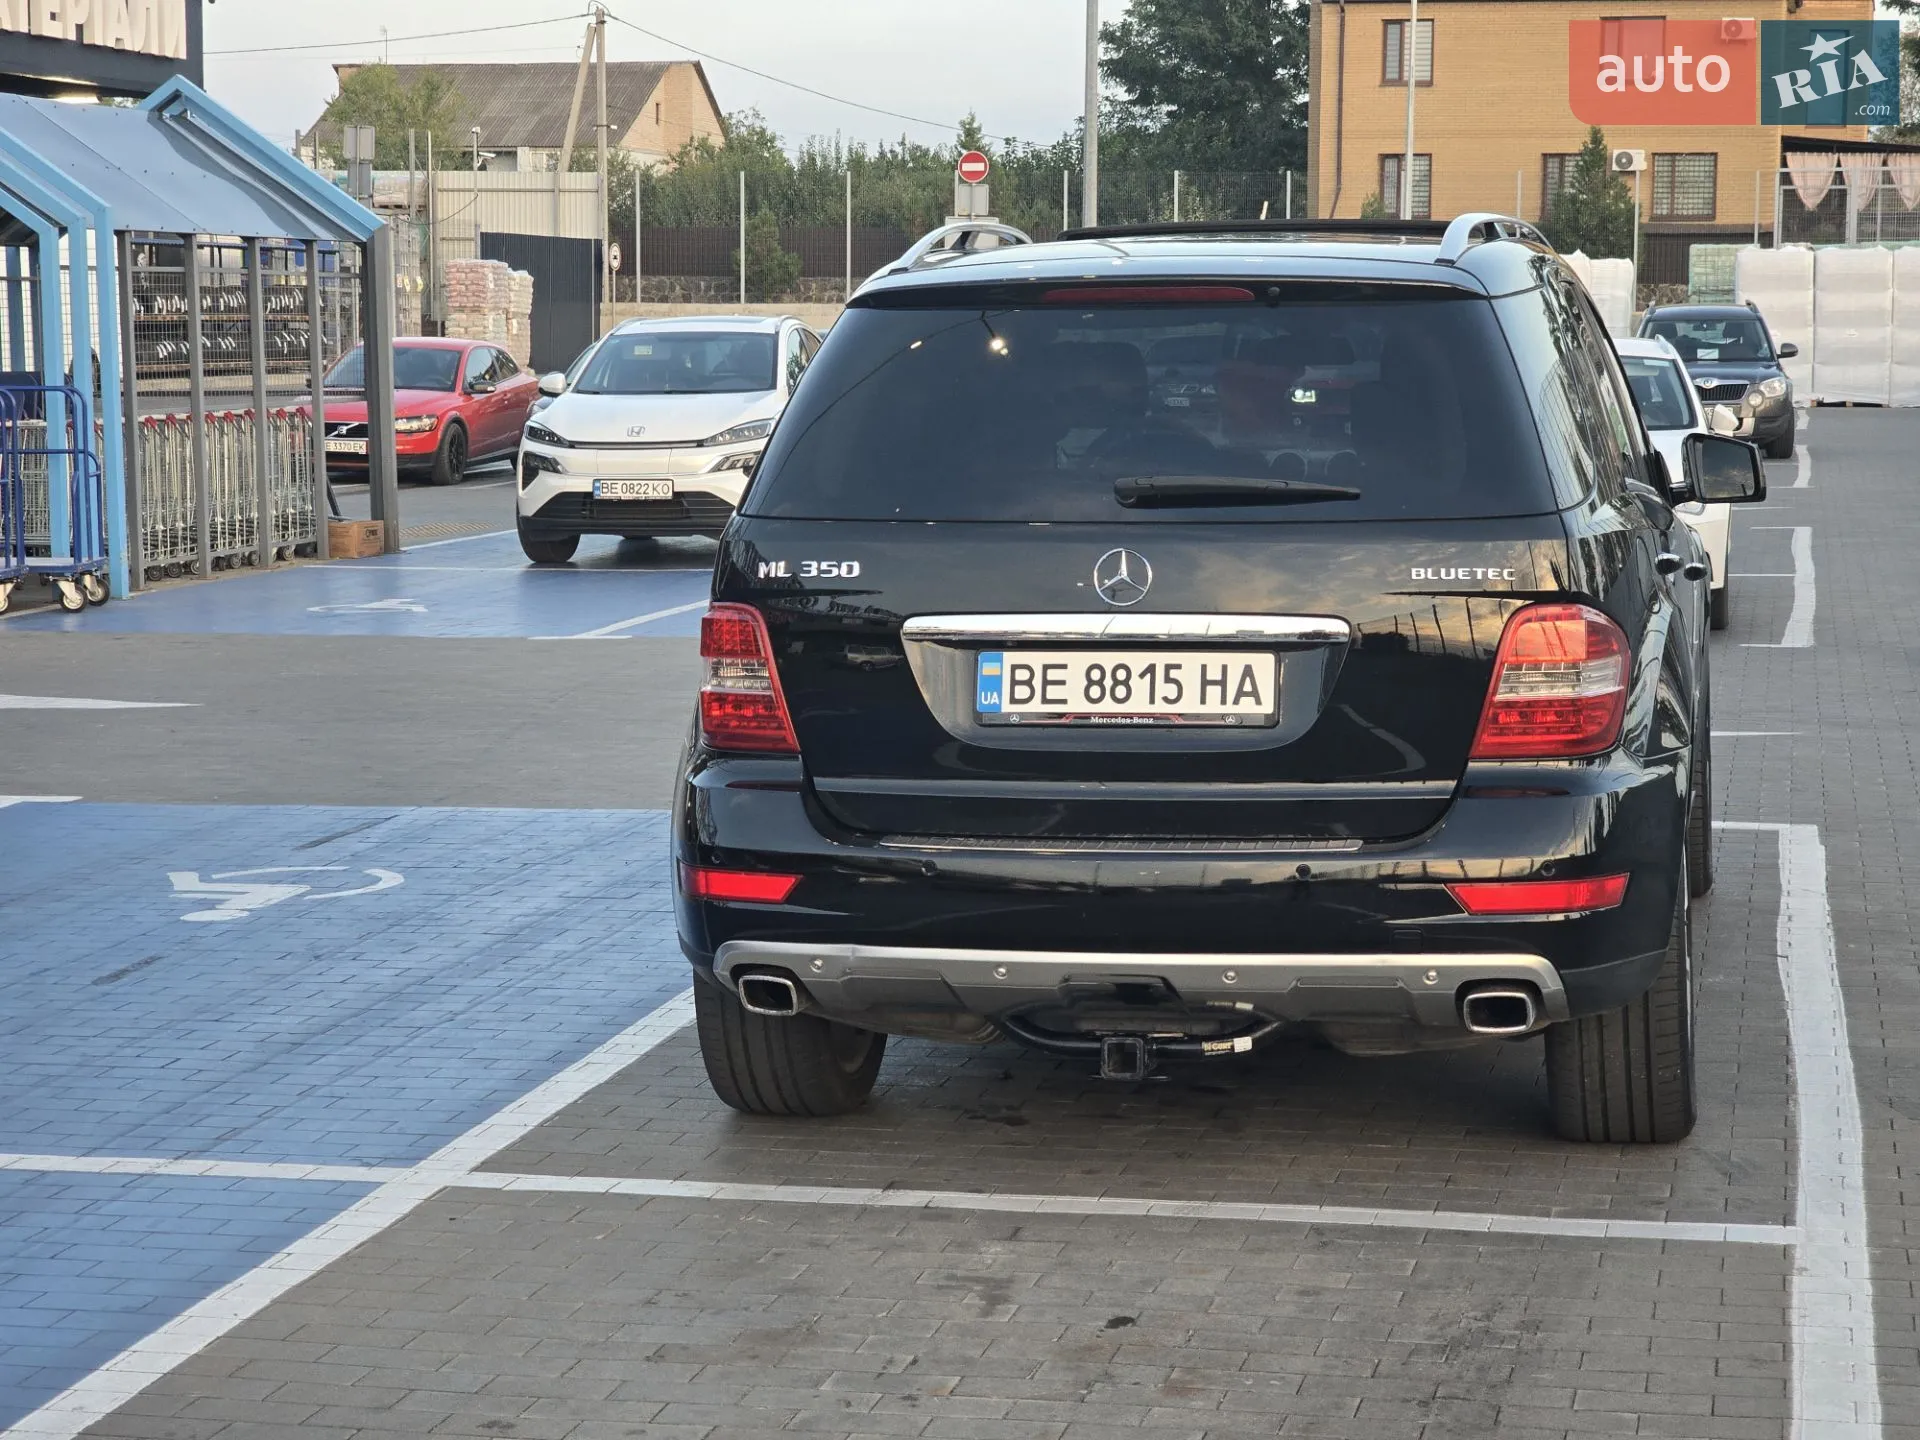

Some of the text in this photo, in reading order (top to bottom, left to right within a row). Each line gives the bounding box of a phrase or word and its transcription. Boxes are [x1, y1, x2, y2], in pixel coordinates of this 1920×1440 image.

[353, 442, 365, 451] EK
[601, 482, 619, 495] BE
[621, 482, 650, 495] 0822
[652, 483, 670, 495] KO
[758, 560, 860, 579] ML 350
[1410, 567, 1516, 581] BLUETEC
[1009, 663, 1263, 706] BE 8815 HA
[981, 691, 1000, 705] UA
[1089, 716, 1155, 724] Mercedes-Benz
